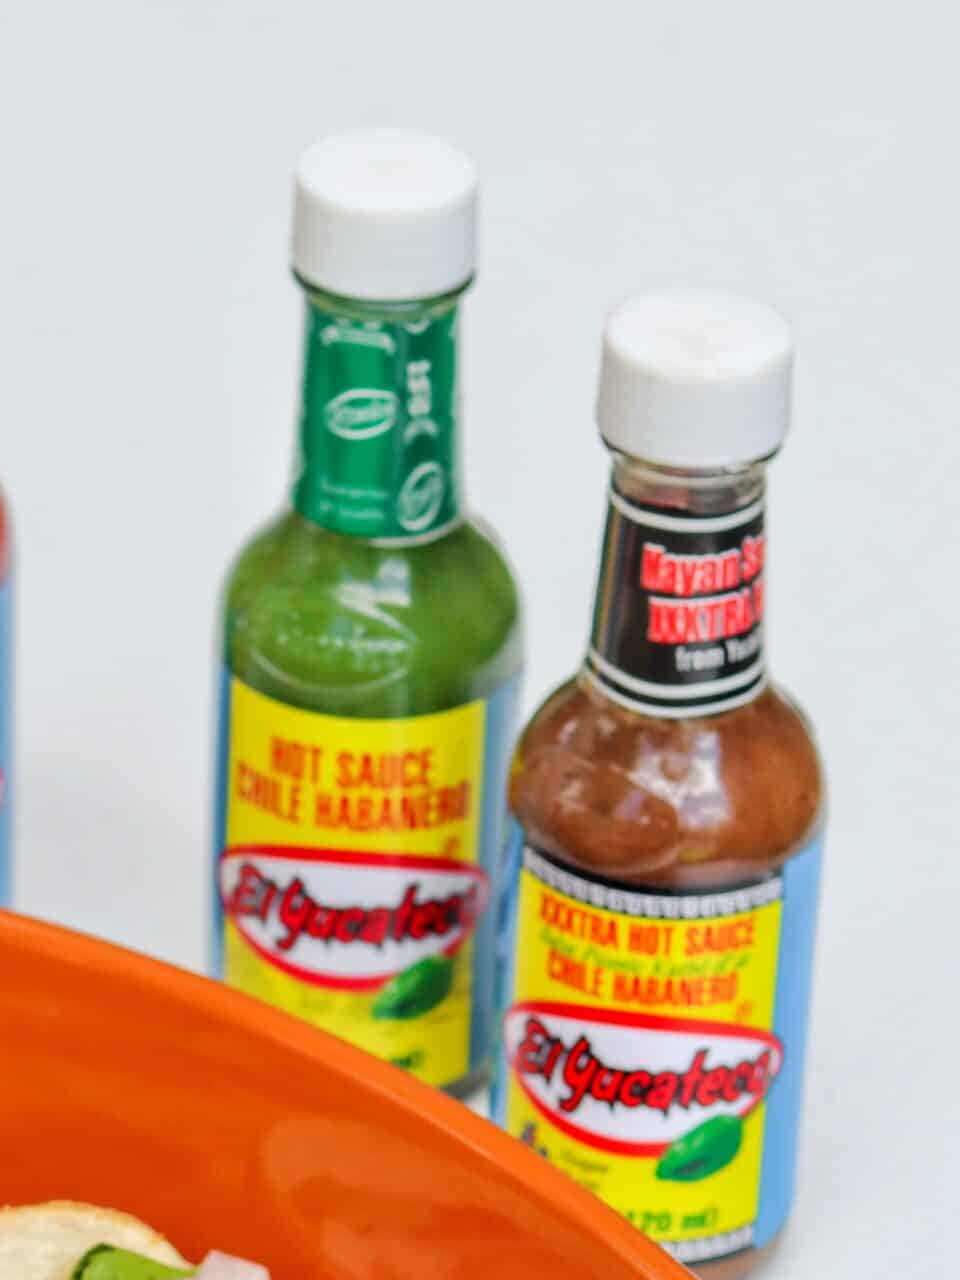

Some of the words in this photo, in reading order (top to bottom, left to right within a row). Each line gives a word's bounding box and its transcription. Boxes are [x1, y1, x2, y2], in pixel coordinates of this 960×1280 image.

[271, 736, 321, 783] HOT
[336, 748, 434, 790] SAUCE
[237, 761, 300, 824] CHILE
[314, 779, 471, 833] HABANERO
[627, 921, 675, 957] HOT
[684, 910, 756, 957] SAUCE
[548, 947, 604, 998] CHILE
[612, 972, 738, 1006] HABANERO
[516, 1016, 564, 1084] El
